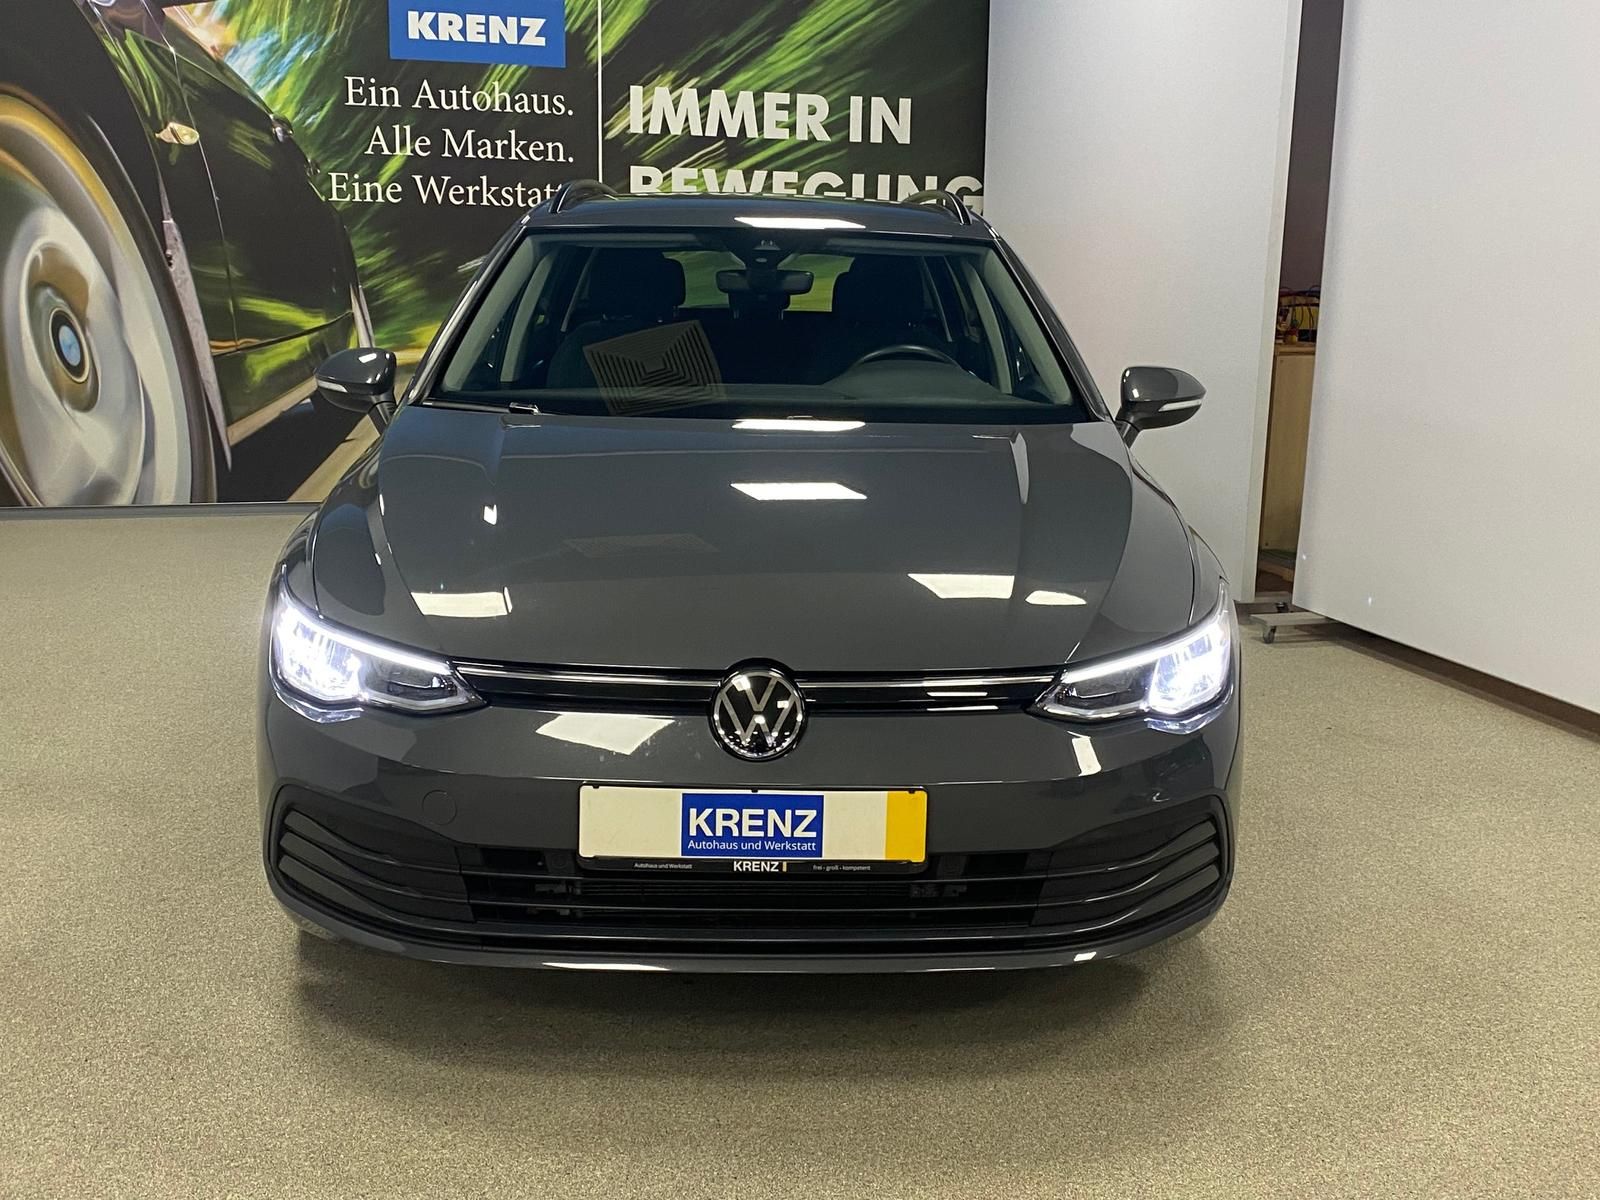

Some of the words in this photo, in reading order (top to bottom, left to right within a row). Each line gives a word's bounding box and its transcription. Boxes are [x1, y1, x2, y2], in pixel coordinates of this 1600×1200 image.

[407, 10, 546, 47] KRENZ
[344, 76, 402, 108] Ein
[411, 79, 574, 116] Autohaus.
[629, 85, 832, 142] IMMER
[849, 96, 912, 144] IN
[364, 124, 431, 157] Alle
[441, 128, 574, 163] Marken.
[327, 172, 402, 203] Eine
[412, 174, 563, 208] Werkstat
[689, 807, 817, 838] KRENZ
[687, 839, 738, 850] Autohaus
[741, 841, 762, 851] und
[764, 841, 817, 852] Werkstatt
[733, 861, 779, 872] KRENZ
